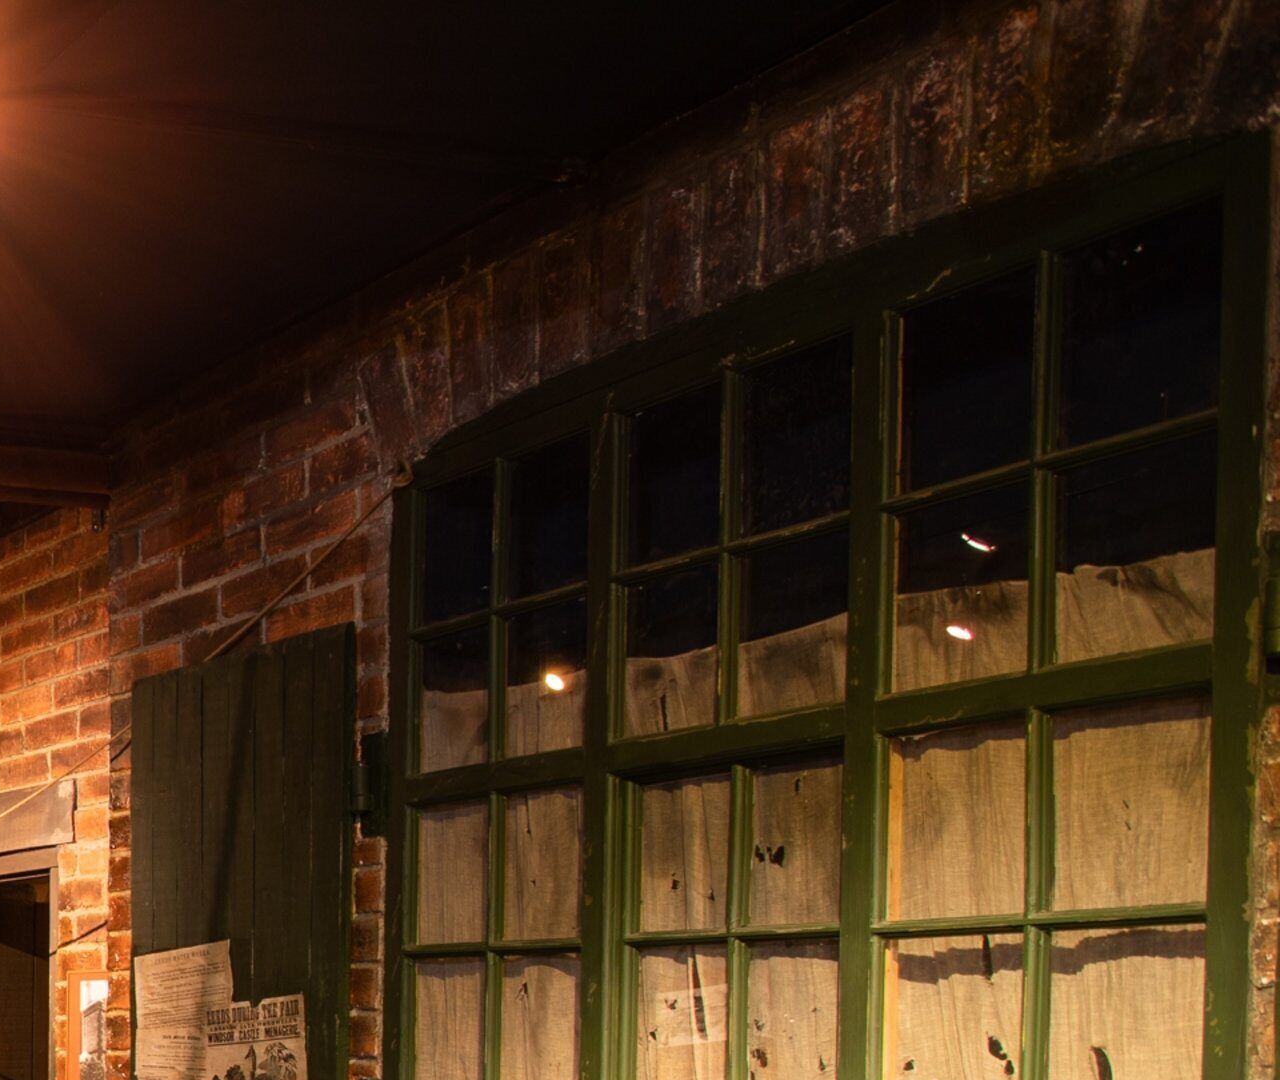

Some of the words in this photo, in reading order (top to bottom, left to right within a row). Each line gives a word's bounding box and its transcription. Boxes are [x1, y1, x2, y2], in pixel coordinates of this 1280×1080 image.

[207, 1009, 230, 1025] LEEDS
[261, 1003, 278, 1019] THE
[280, 1000, 299, 1017] FAIR
[208, 1032, 234, 1043] WINDSOR
[239, 1028, 260, 1041] CASTLE
